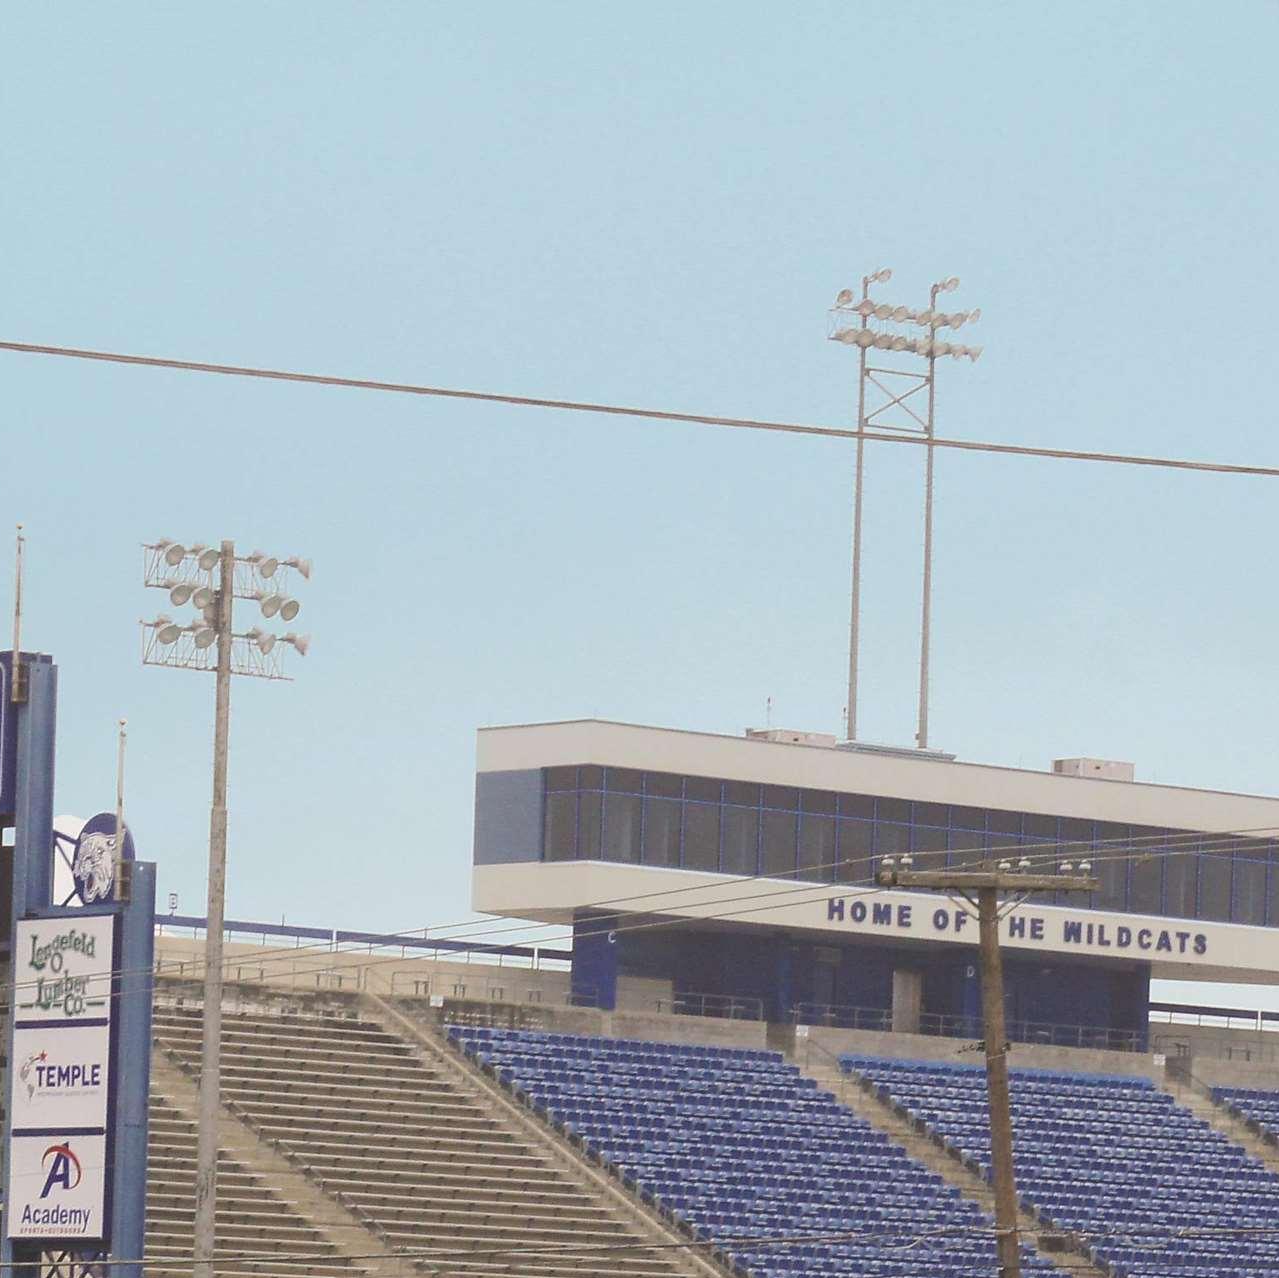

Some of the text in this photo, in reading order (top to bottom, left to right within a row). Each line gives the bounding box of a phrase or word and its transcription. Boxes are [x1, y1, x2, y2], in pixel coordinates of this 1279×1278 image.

[827, 899, 1208, 955] HOME OF HE WILDCATS
[35, 1064, 101, 1088] TEMPLE
[21, 1203, 91, 1233] Academy
